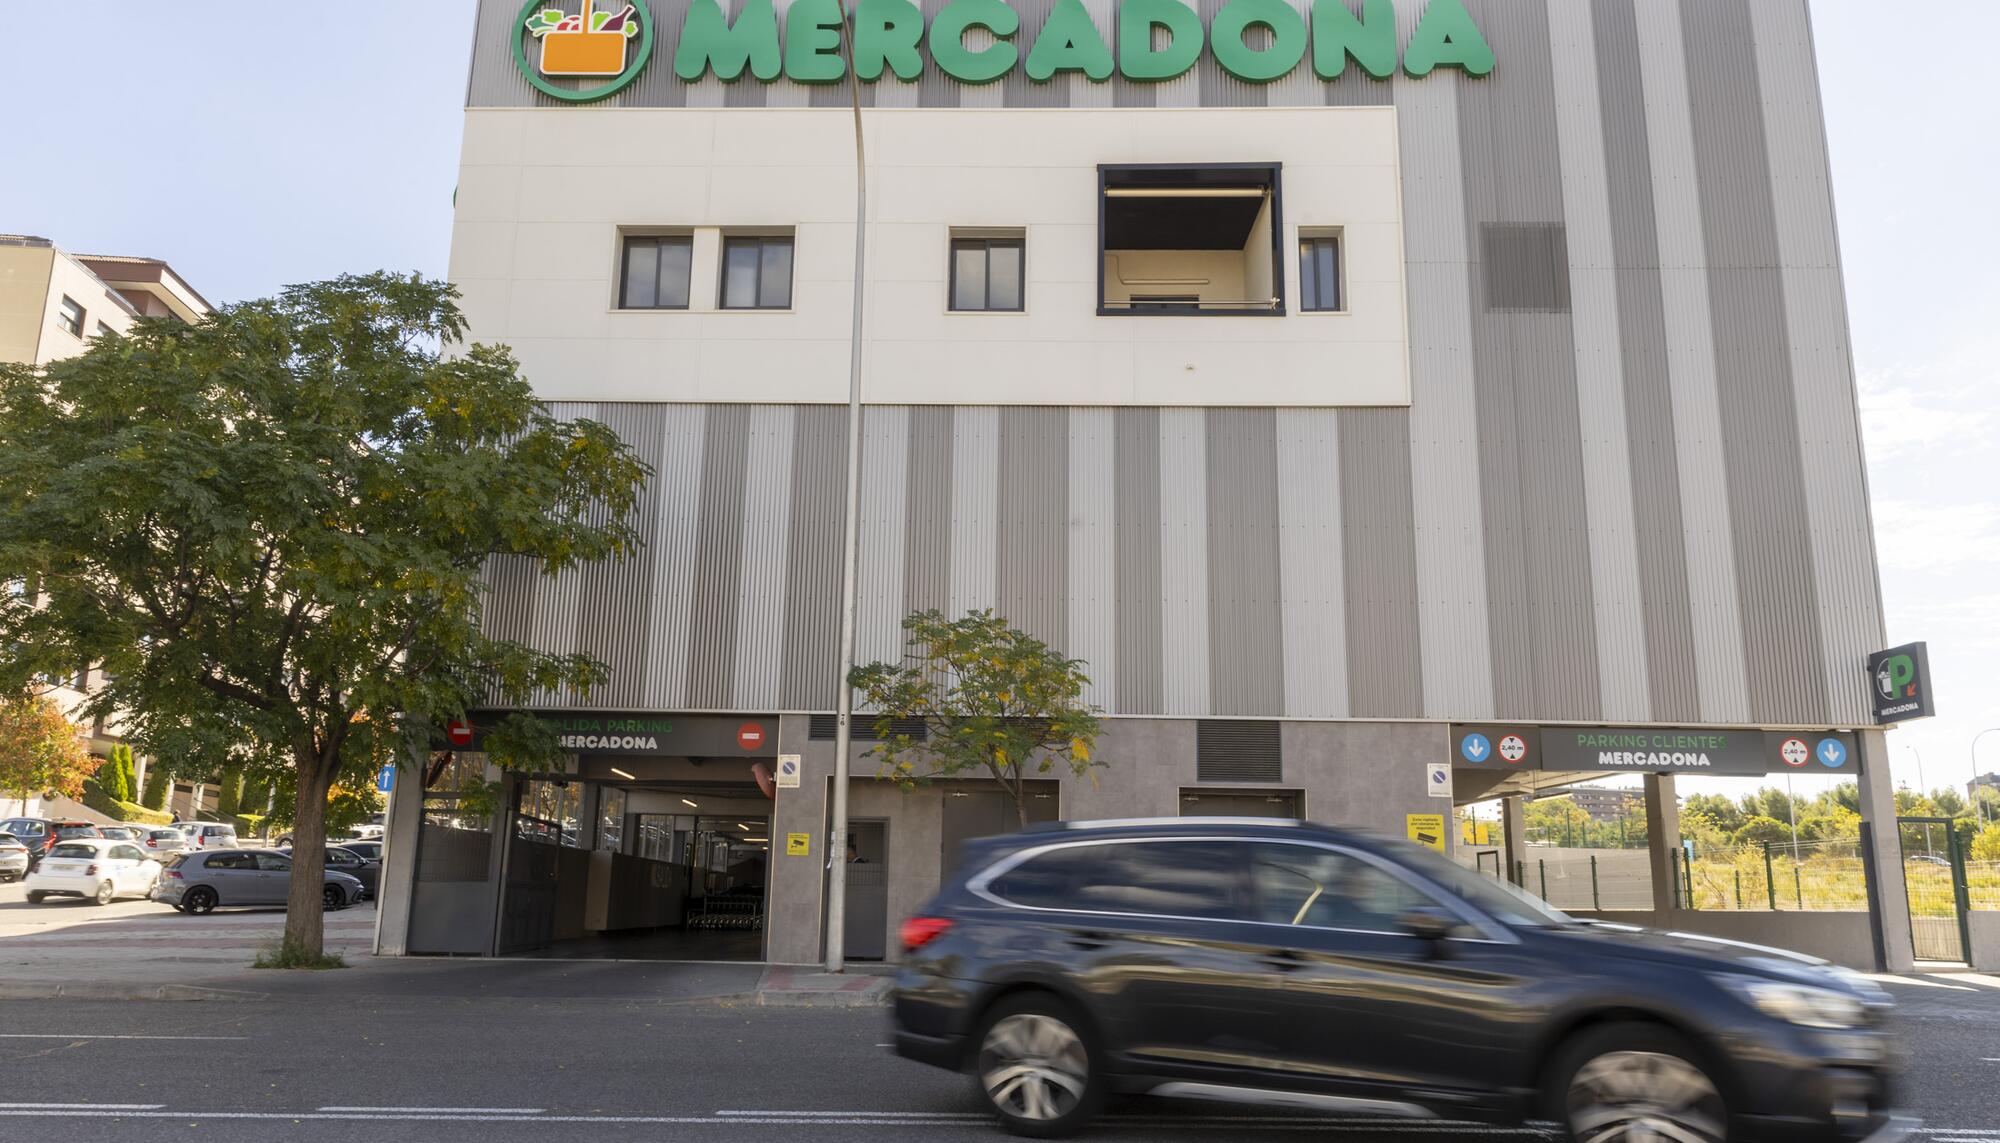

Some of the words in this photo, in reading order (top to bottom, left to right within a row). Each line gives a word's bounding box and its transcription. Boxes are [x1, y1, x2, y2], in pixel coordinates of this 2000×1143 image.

[674, 0, 1496, 84] MERCADONA
[1888, 654, 1914, 700] P
[1881, 702, 1919, 716] MERCADONA
[607, 720, 673, 733] PARKING
[1577, 734, 1647, 748] PARKING
[1652, 735, 1726, 749] CLIENTES
[1598, 751, 1711, 766] MERCADONA
